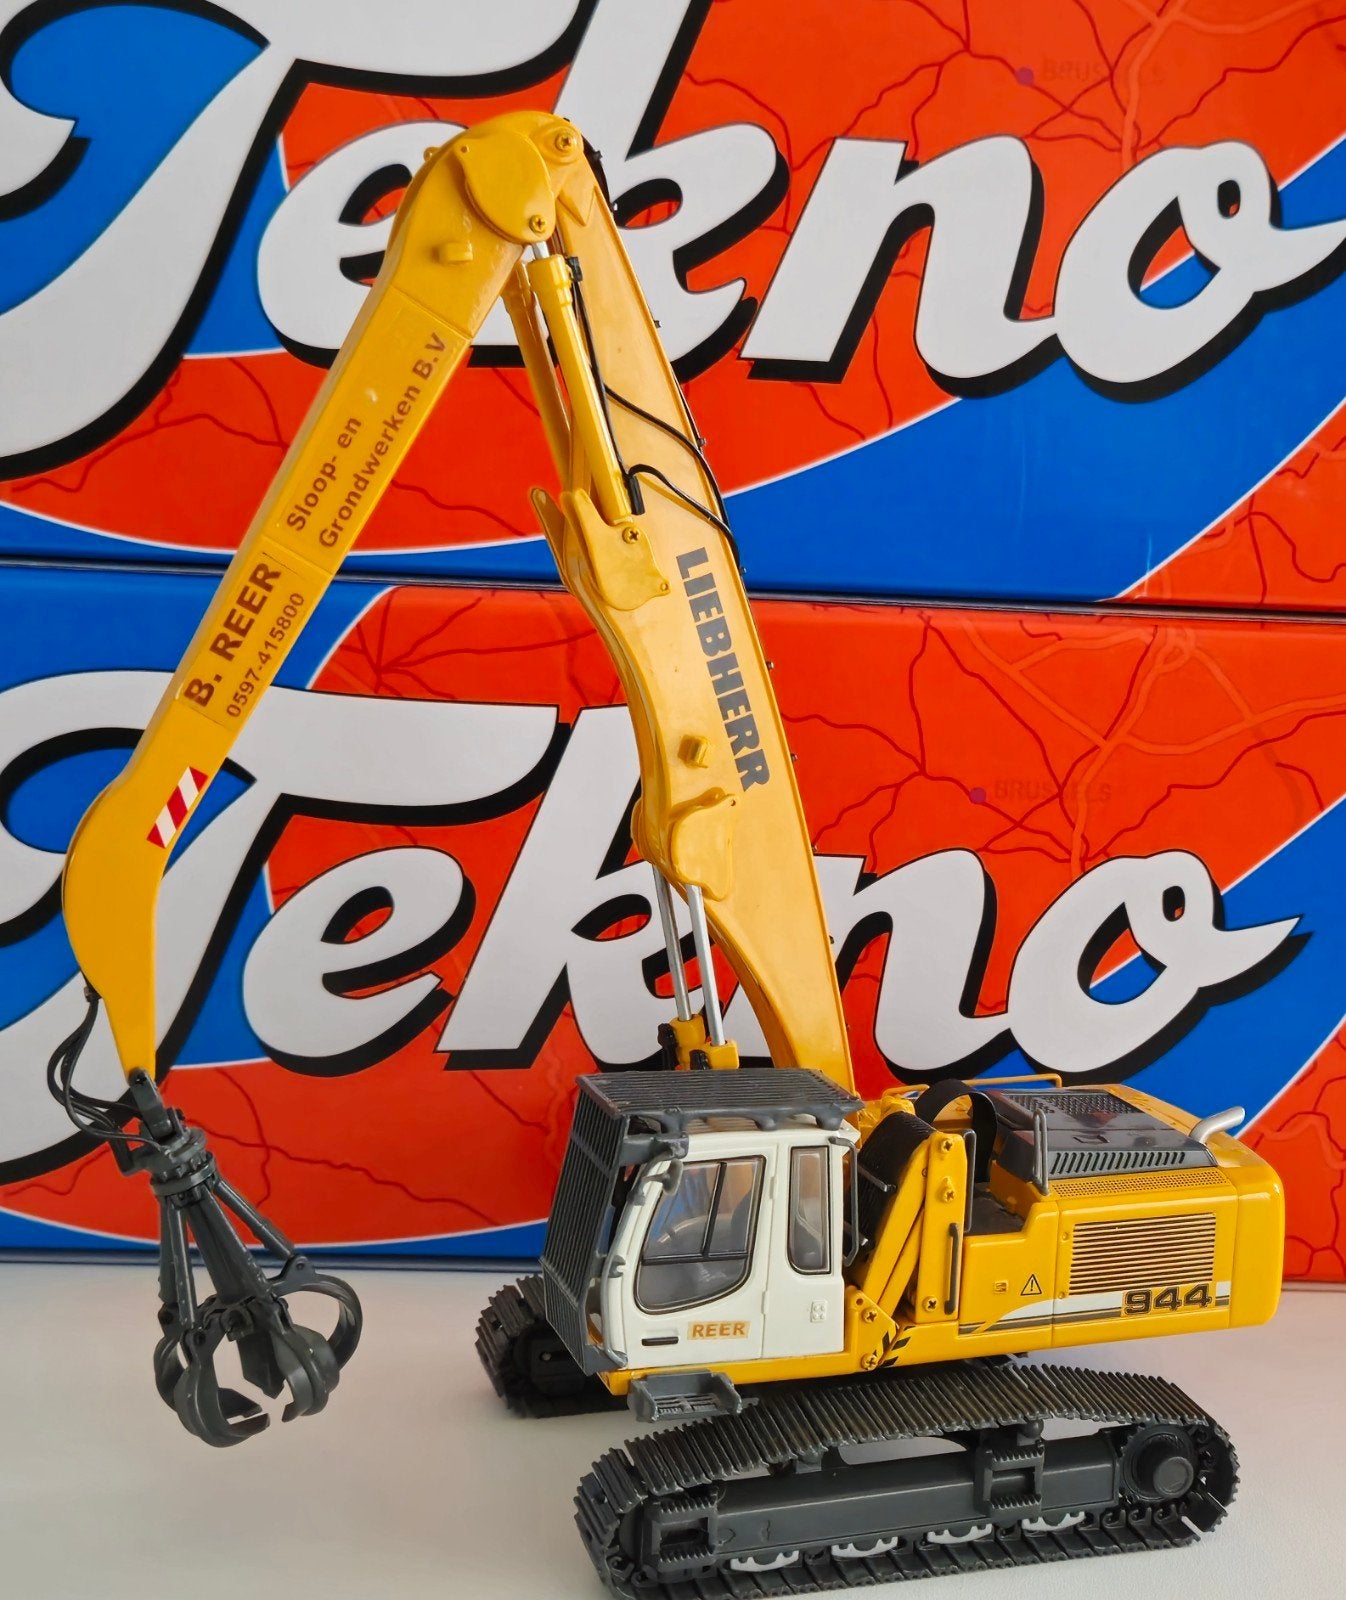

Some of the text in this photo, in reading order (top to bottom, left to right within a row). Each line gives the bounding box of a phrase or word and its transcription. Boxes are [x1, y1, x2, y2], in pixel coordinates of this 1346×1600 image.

[0, 0, 1346, 482] Tekno
[286, 417, 362, 532] Sloop- en
[318, 332, 446, 548] Grondwerken B.V
[183, 562, 282, 708] B. REER
[226, 592, 304, 718] 0597-415800
[675, 546, 771, 792] LIEBHERR
[0, 668, 1313, 1188] Tekno
[692, 1322, 745, 1338] REER
[1123, 1283, 1213, 1315] 944
